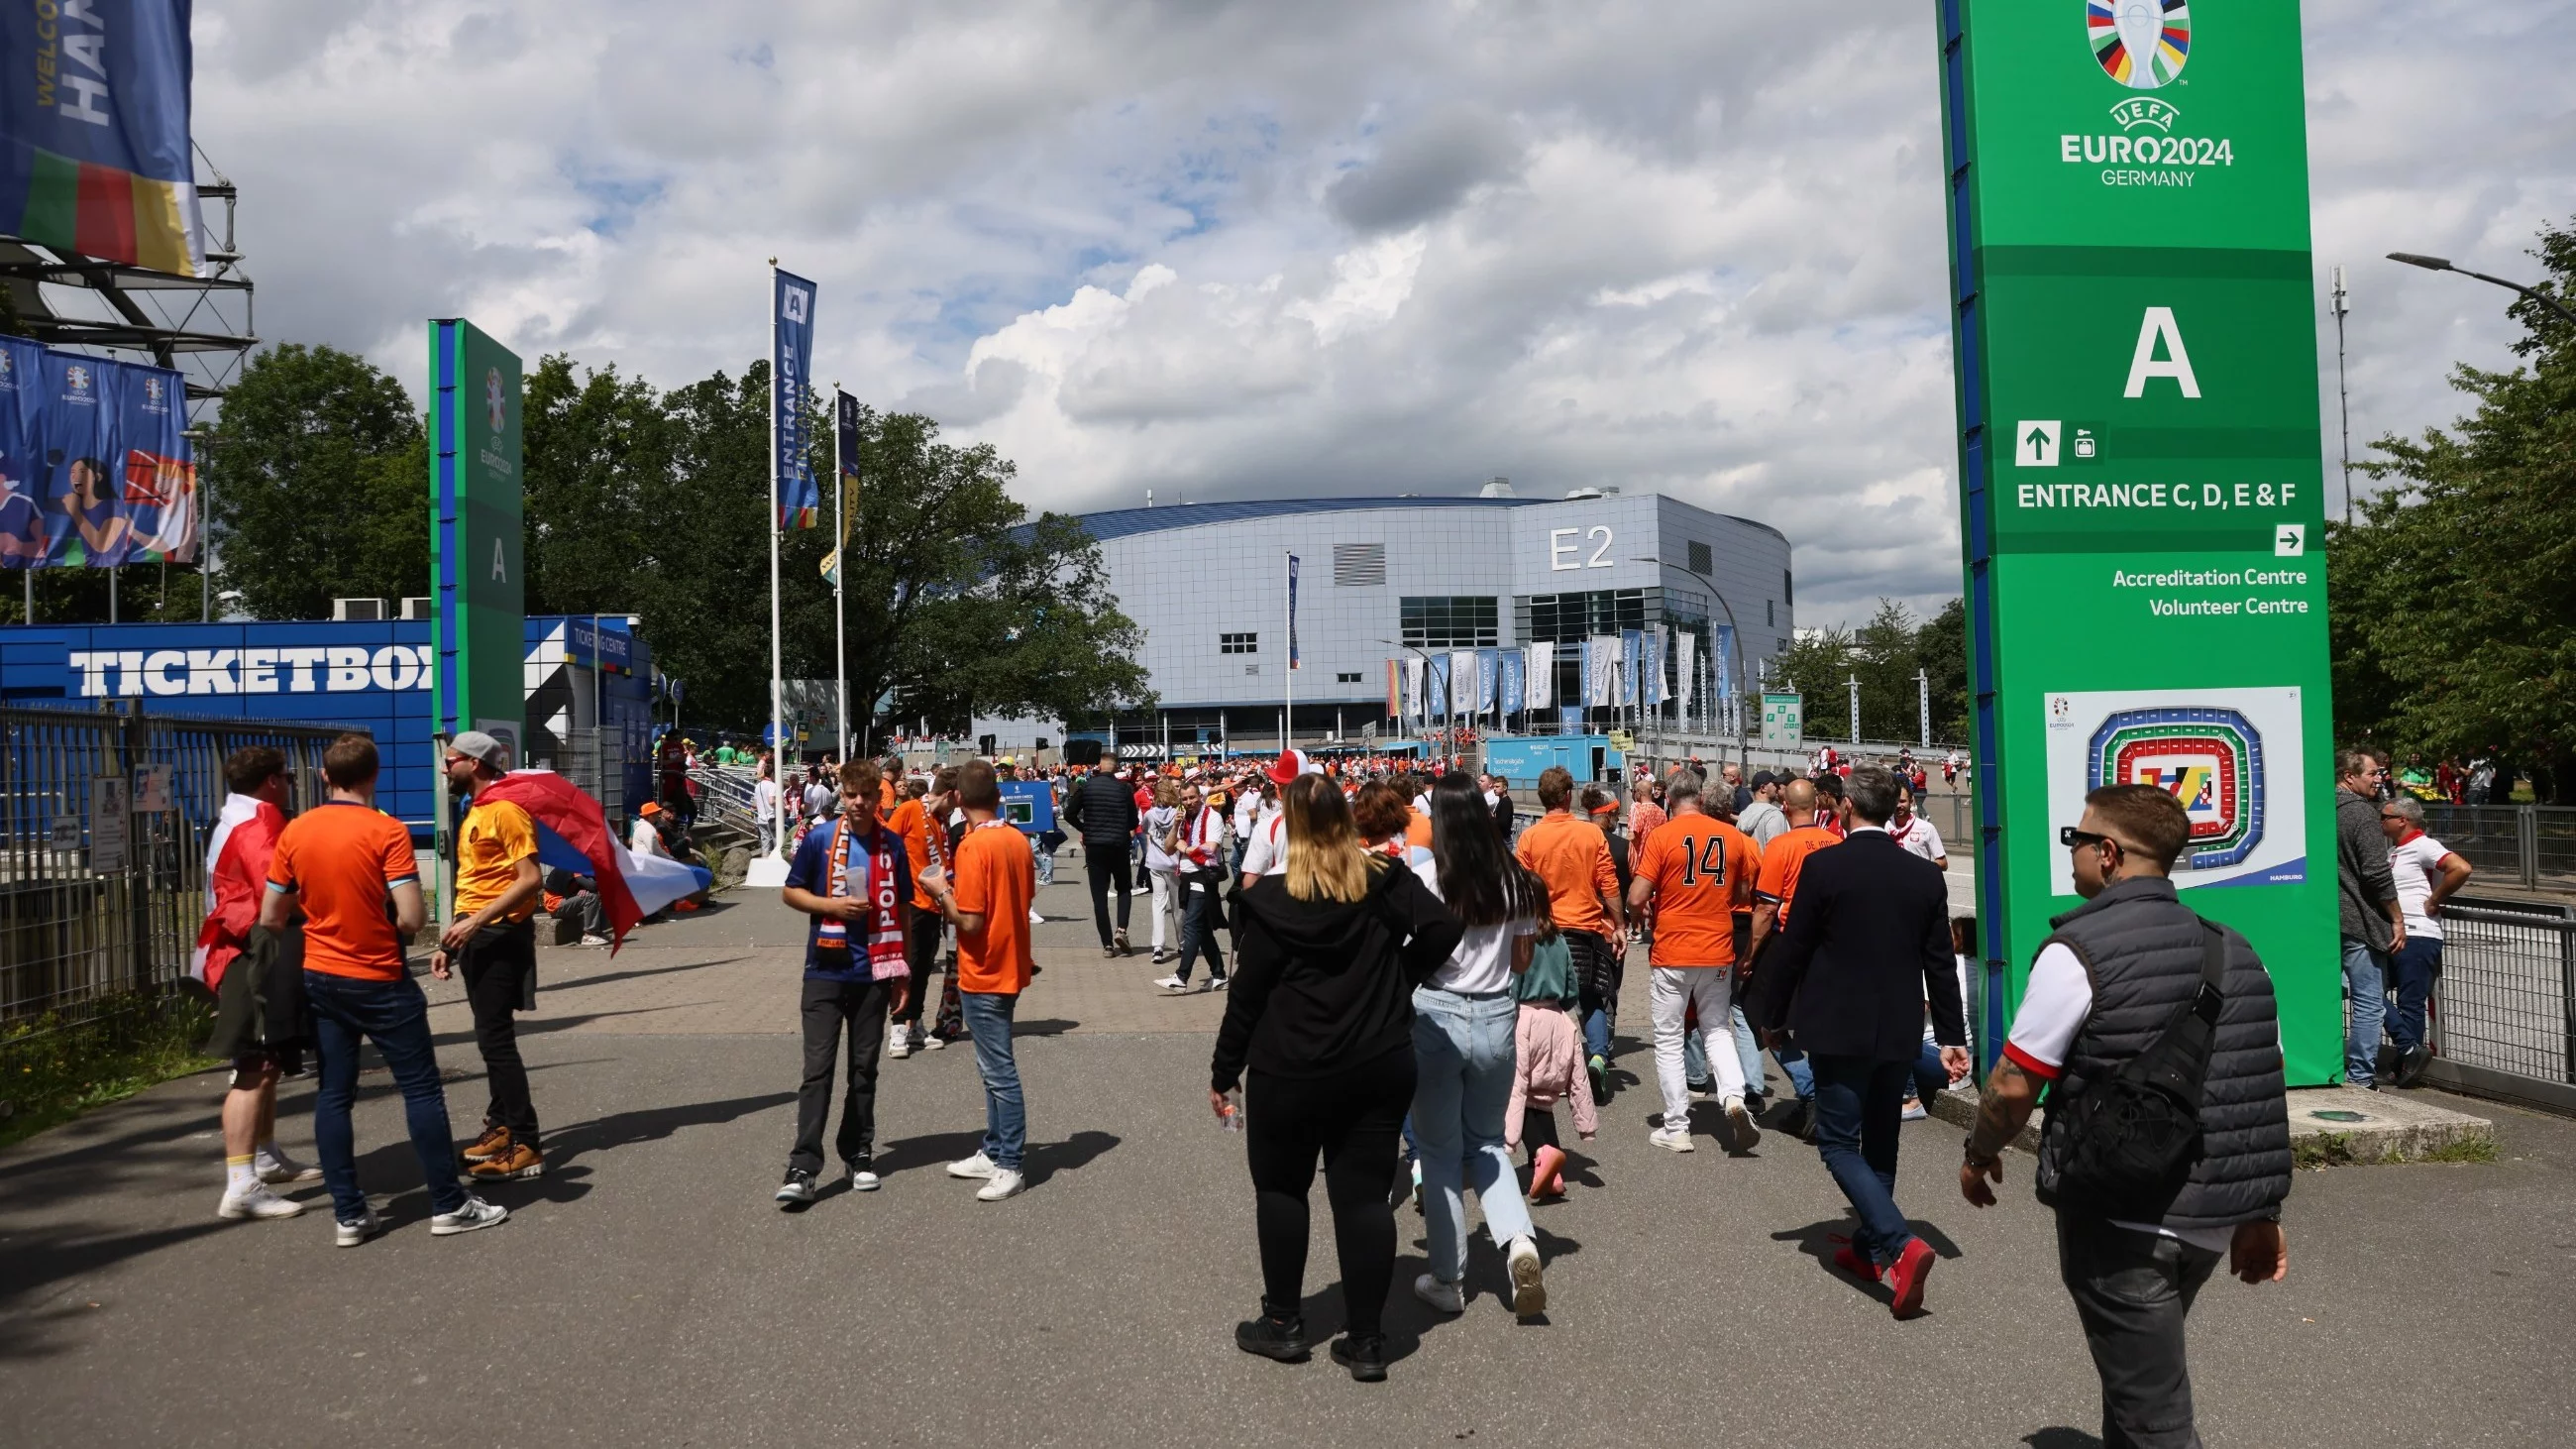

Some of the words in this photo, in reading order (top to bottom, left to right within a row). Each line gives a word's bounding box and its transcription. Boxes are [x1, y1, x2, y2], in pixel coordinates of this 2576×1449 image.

[2113, 102, 2174, 129] UEFA
[2061, 135, 2234, 167] EURO2024
[2101, 169, 2196, 187] GERMANY
[789, 293, 803, 317] A
[2123, 307, 2201, 398] A
[783, 344, 797, 480] ENTRANCE
[2017, 484, 2167, 507] ENTRANCE
[2173, 483, 2198, 510] C,
[2203, 483, 2228, 510] D,
[2234, 483, 2250, 506] E
[2255, 483, 2276, 506] &
[2281, 483, 2296, 506] F
[491, 537, 506, 584] A
[1551, 525, 1614, 571] E2
[2113, 569, 2241, 587] Accreditation
[2244, 568, 2308, 586] Centre
[2149, 598, 2242, 616] Volunteer
[2245, 597, 2308, 614] Centre
[1482, 657, 1491, 695] BARCLAYS
[1681, 835, 1726, 887] 14
[878, 833, 898, 928] POLS
[874, 952, 904, 962] POLSKA
